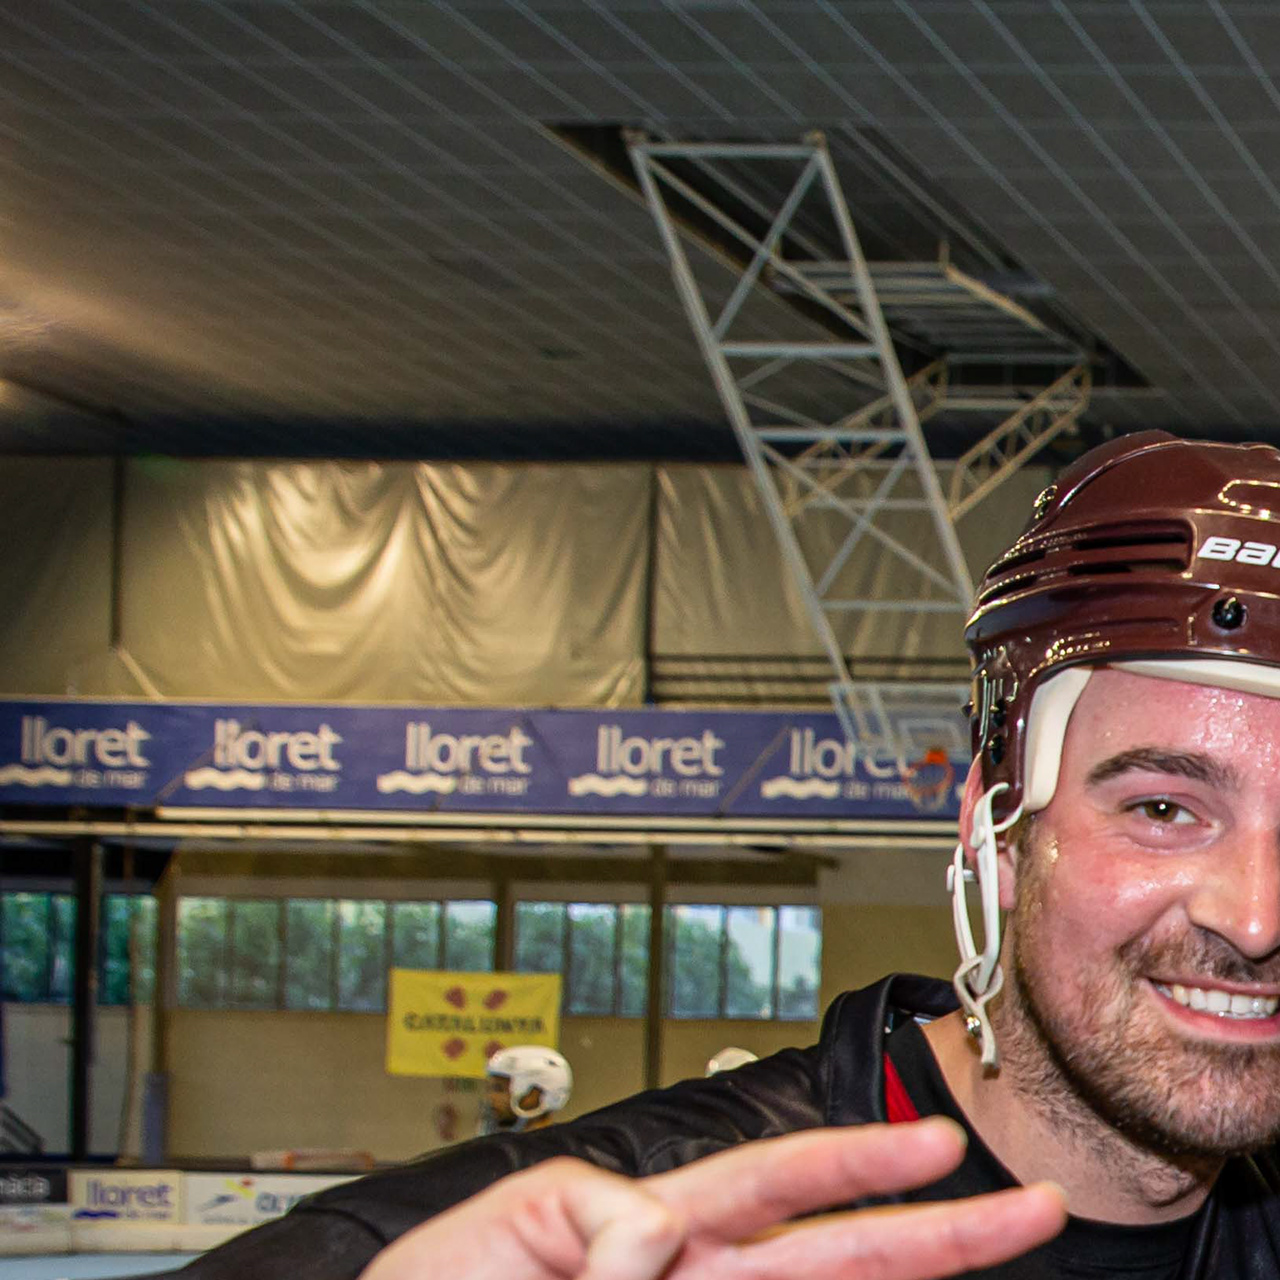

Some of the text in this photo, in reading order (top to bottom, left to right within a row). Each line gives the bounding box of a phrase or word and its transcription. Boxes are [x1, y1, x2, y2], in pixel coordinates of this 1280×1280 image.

[21, 715, 151, 768] lloret
[214, 718, 342, 771] lloret
[406, 721, 533, 774] lloret
[598, 724, 726, 777] lloret
